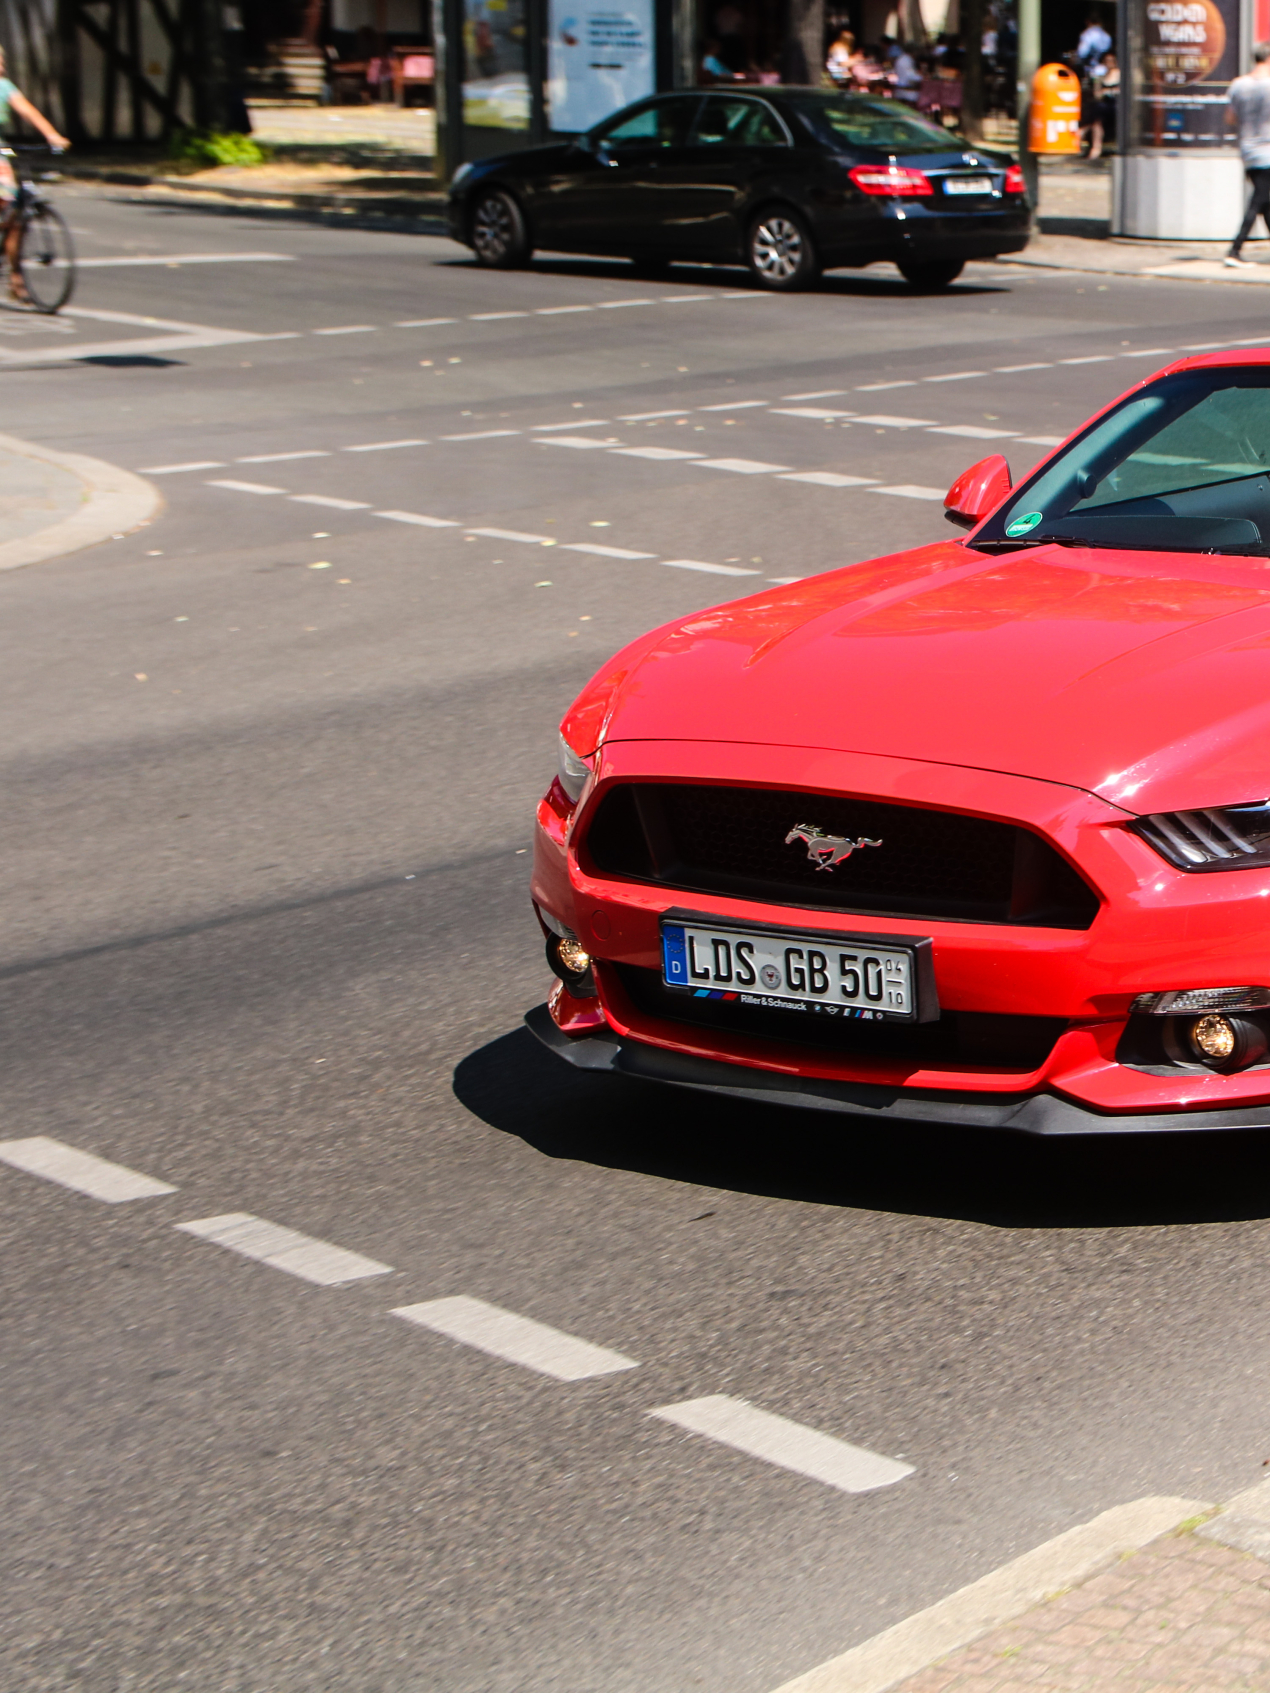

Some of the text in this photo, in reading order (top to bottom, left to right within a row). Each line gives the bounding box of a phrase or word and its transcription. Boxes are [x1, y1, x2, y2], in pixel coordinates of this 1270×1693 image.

[671, 960, 682, 974] D
[688, 935, 884, 1002] LDS GB 50
[886, 958, 904, 972] 04
[888, 990, 903, 1004] 10
